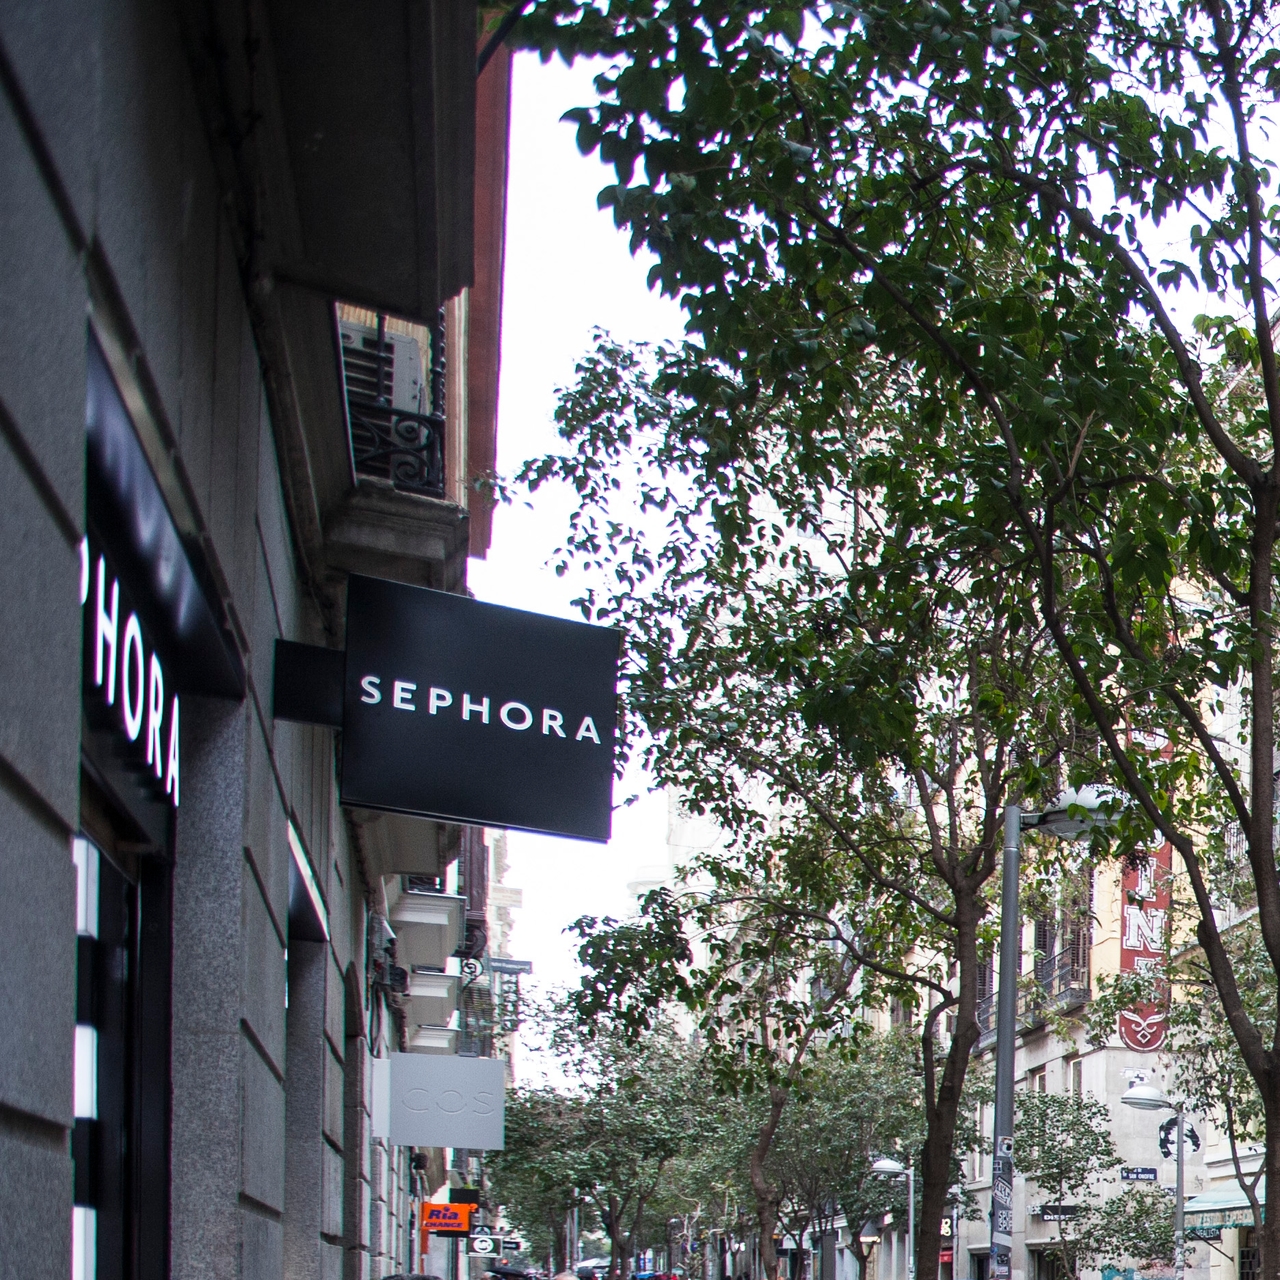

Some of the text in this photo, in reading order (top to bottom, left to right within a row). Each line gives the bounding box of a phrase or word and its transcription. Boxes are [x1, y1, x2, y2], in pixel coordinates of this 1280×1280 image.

[360, 675, 602, 745] SEPHORA
[402, 1088, 495, 1117] COS
[428, 1206, 459, 1220] Ria
